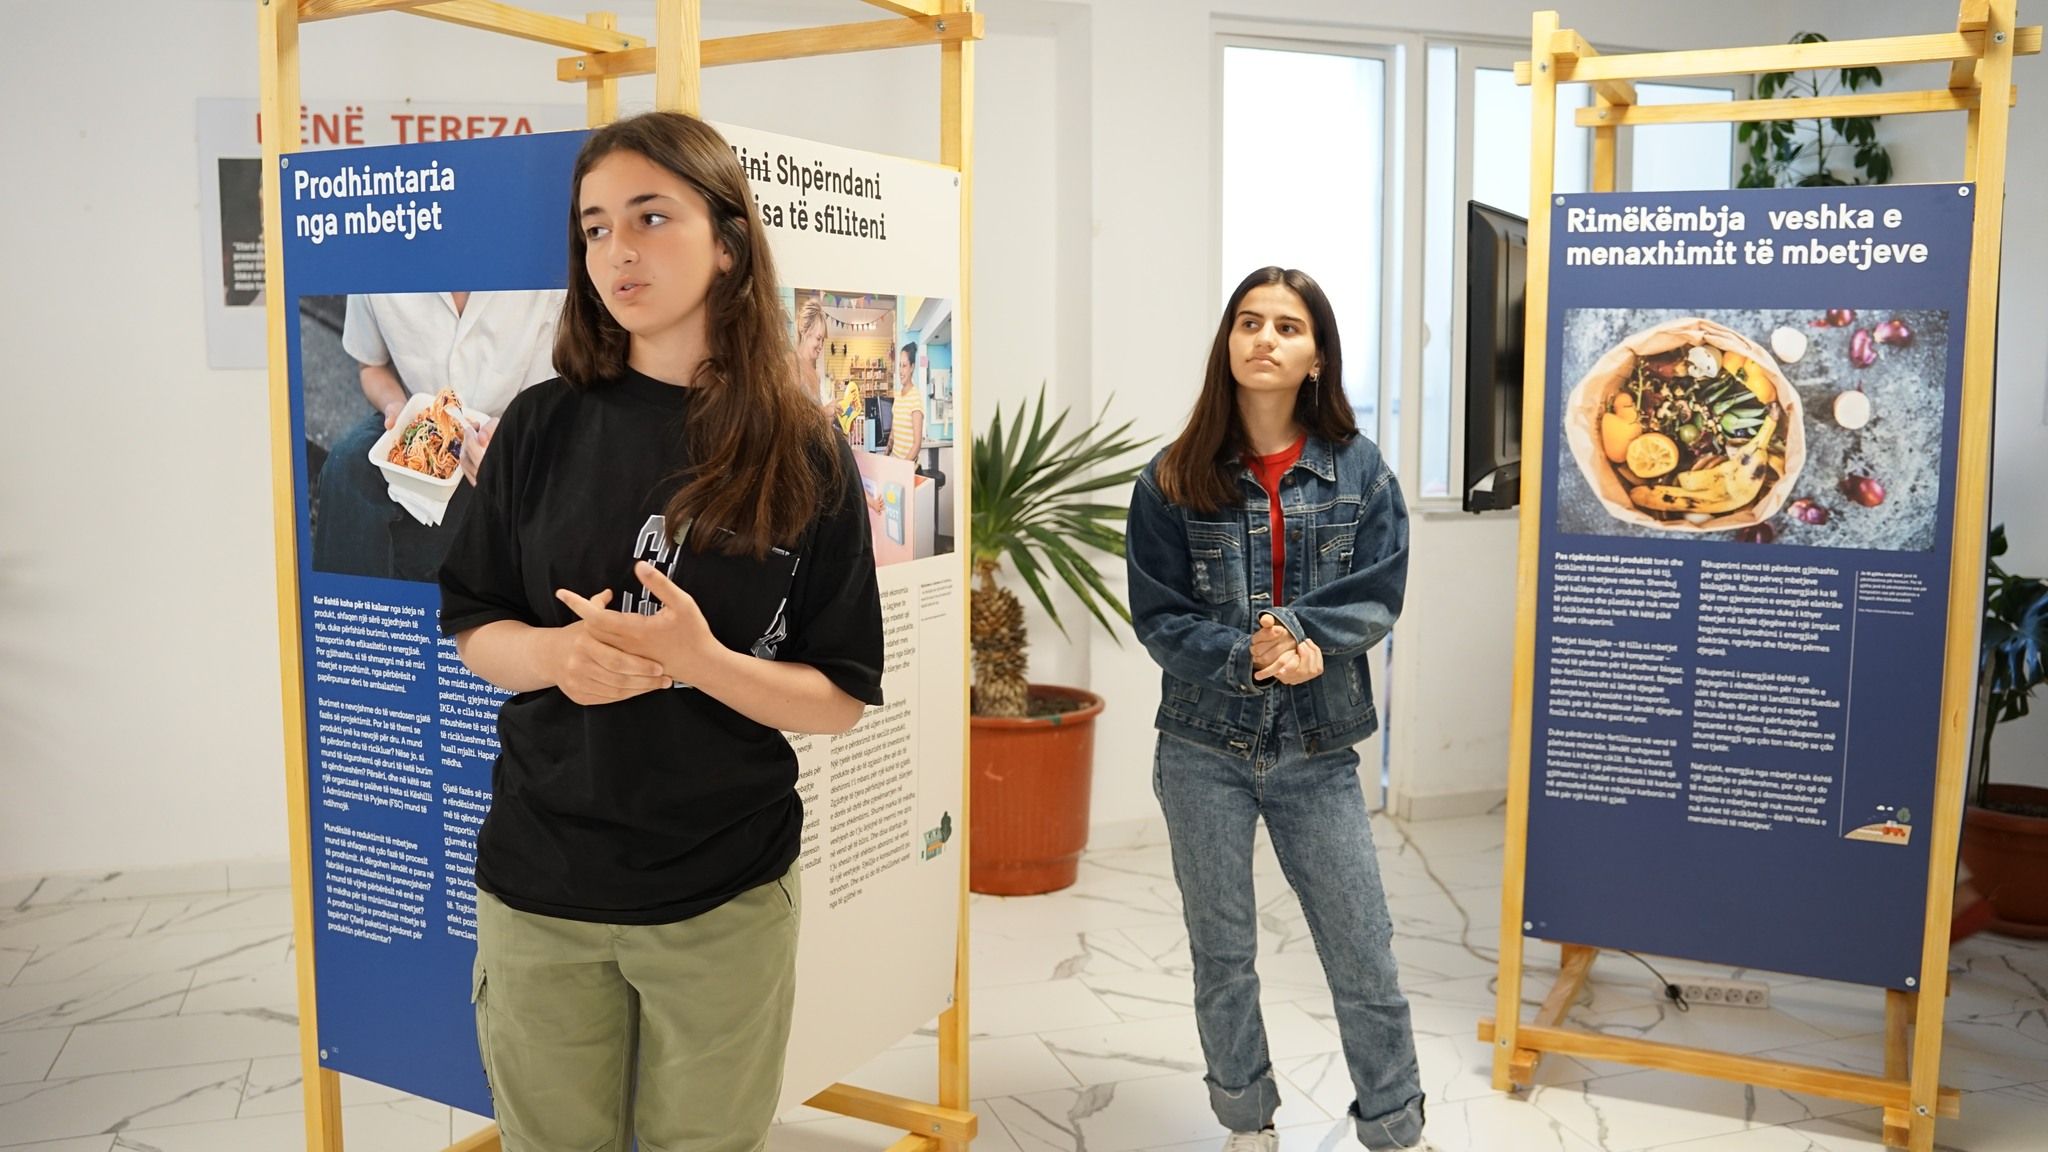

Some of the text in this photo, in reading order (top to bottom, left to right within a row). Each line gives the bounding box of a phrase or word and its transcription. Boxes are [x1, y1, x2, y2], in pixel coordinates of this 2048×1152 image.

[295, 161, 455, 200] Prodhimtaria
[777, 154, 882, 200] Shpërndani
[296, 201, 443, 244] nga mbetjet
[790, 201, 809, 230] të
[814, 205, 887, 240] sfiliteni
[1567, 203, 1902, 238] Rimëkëmbja veshka e
[1567, 238, 1929, 271] menaxhimit të mbetjeve
[390, 606, 401, 615] nga
[359, 615, 368, 624] një
[345, 639, 355, 647] dhe
[395, 658, 404, 666] më
[372, 670, 382, 678] nga
[460, 666, 470, 676] dhe
[473, 722, 479, 731] të
[490, 725, 497, 734] të
[440, 731, 447, 739] të
[444, 809, 453, 819] më
[454, 811, 460, 820] të
[446, 877, 457, 887] nga
[446, 888, 456, 897] më
